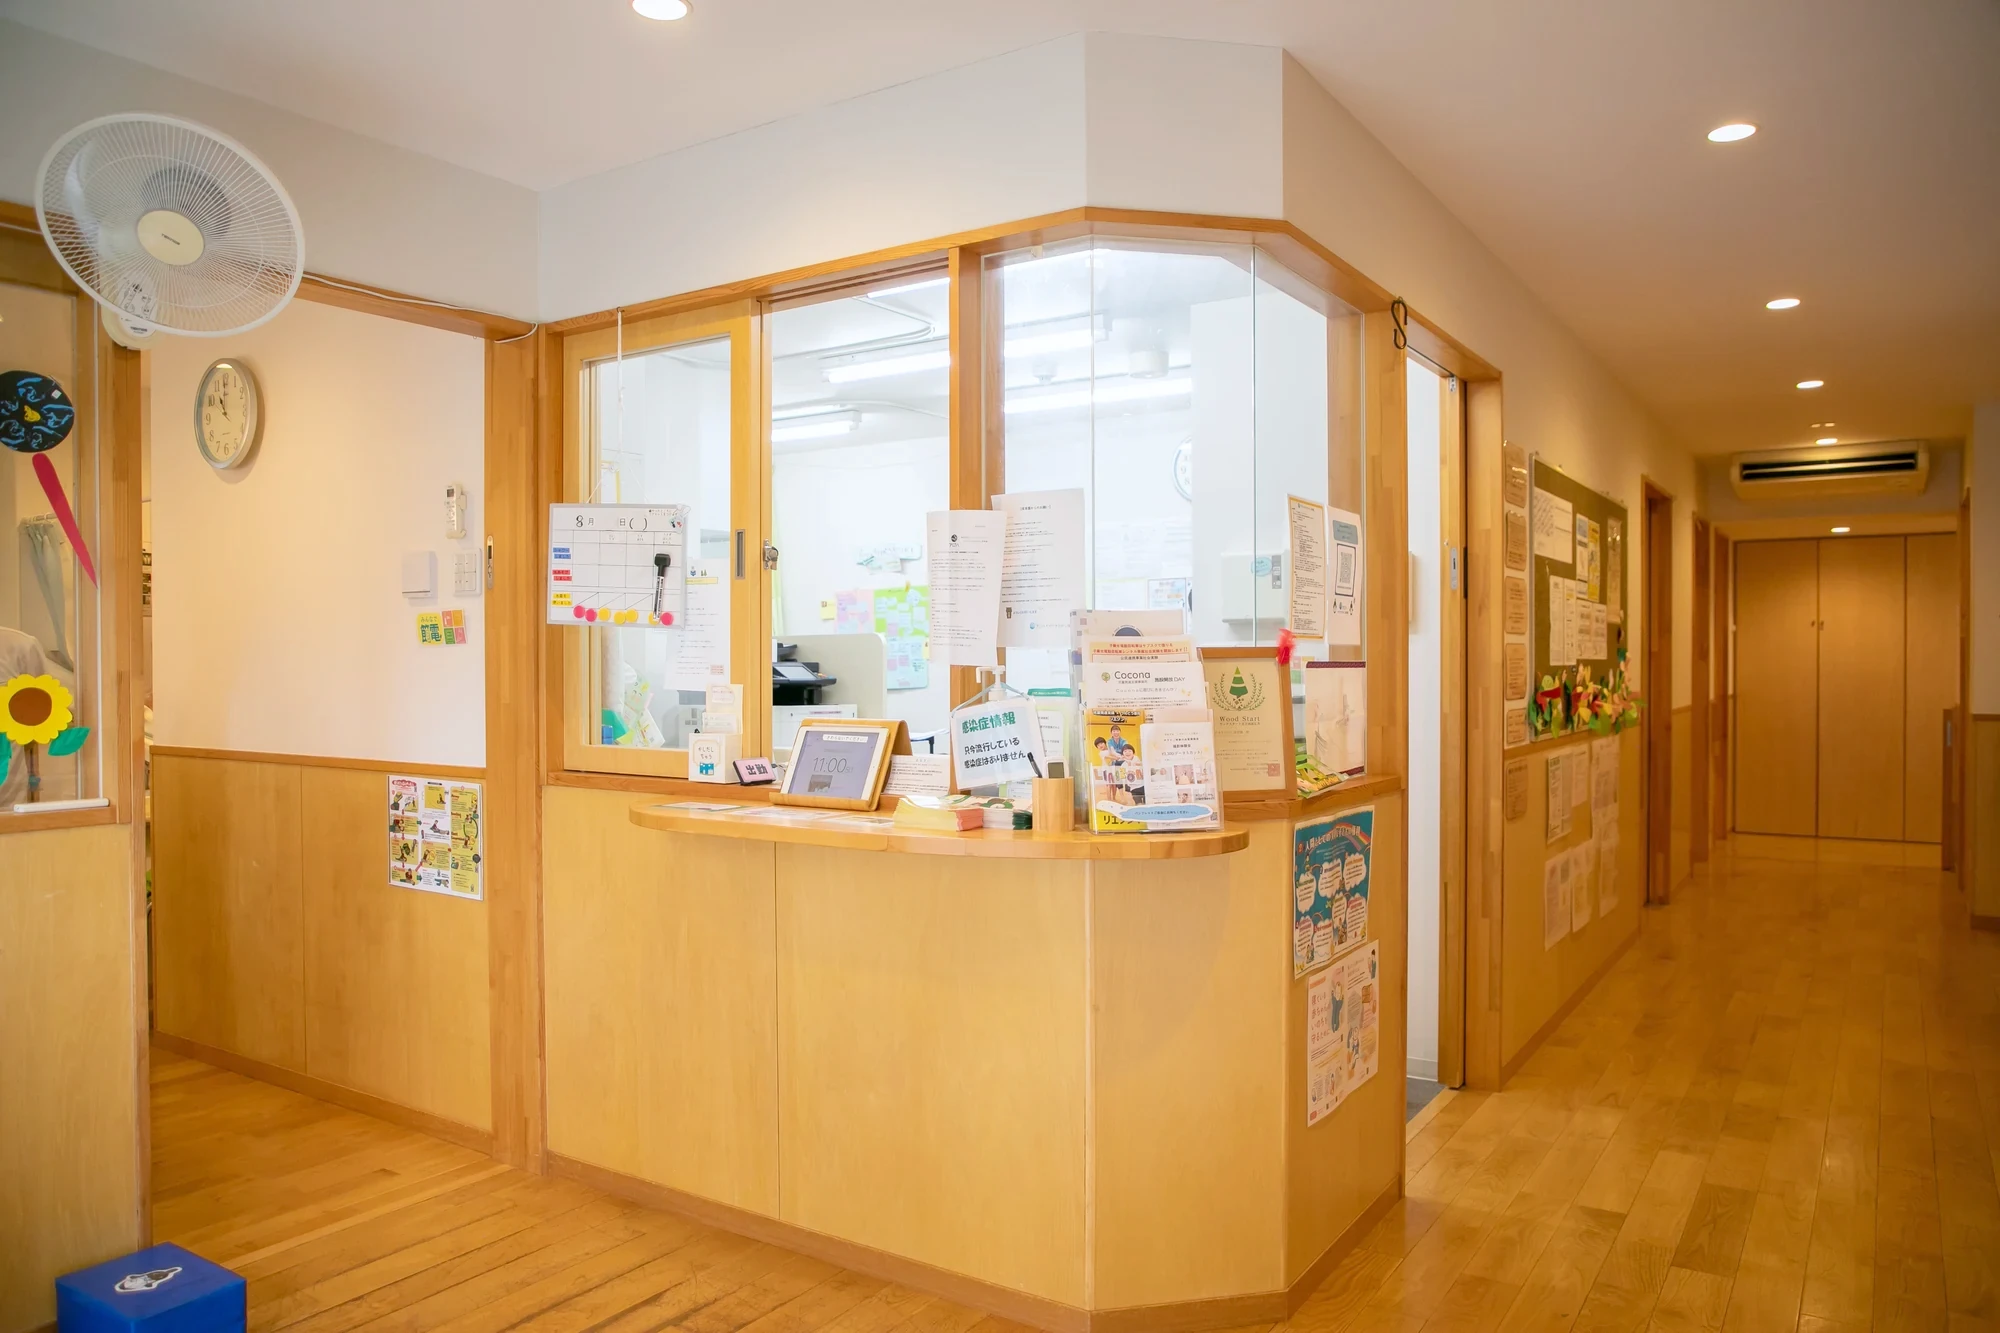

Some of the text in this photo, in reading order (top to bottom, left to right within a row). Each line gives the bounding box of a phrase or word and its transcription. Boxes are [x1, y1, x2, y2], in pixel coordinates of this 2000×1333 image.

[214, 380, 220, 392] 11
[239, 387, 244, 399] 2
[208, 394, 215, 407] 10
[205, 413, 211, 425] 9
[209, 430, 214, 442] 8
[216, 441, 221, 453] 7
[223, 443, 229, 455] 6
[233, 438, 239, 450] 5
[1114, 671, 1151, 679] Cocona
[962, 711, 1016, 733] 感染症情報
[964, 737, 1020, 755] 只今流行している
[813, 757, 848, 773] 11:00
[964, 750, 1026, 769] 感染症はありません
[746, 763, 769, 776] 出勤
